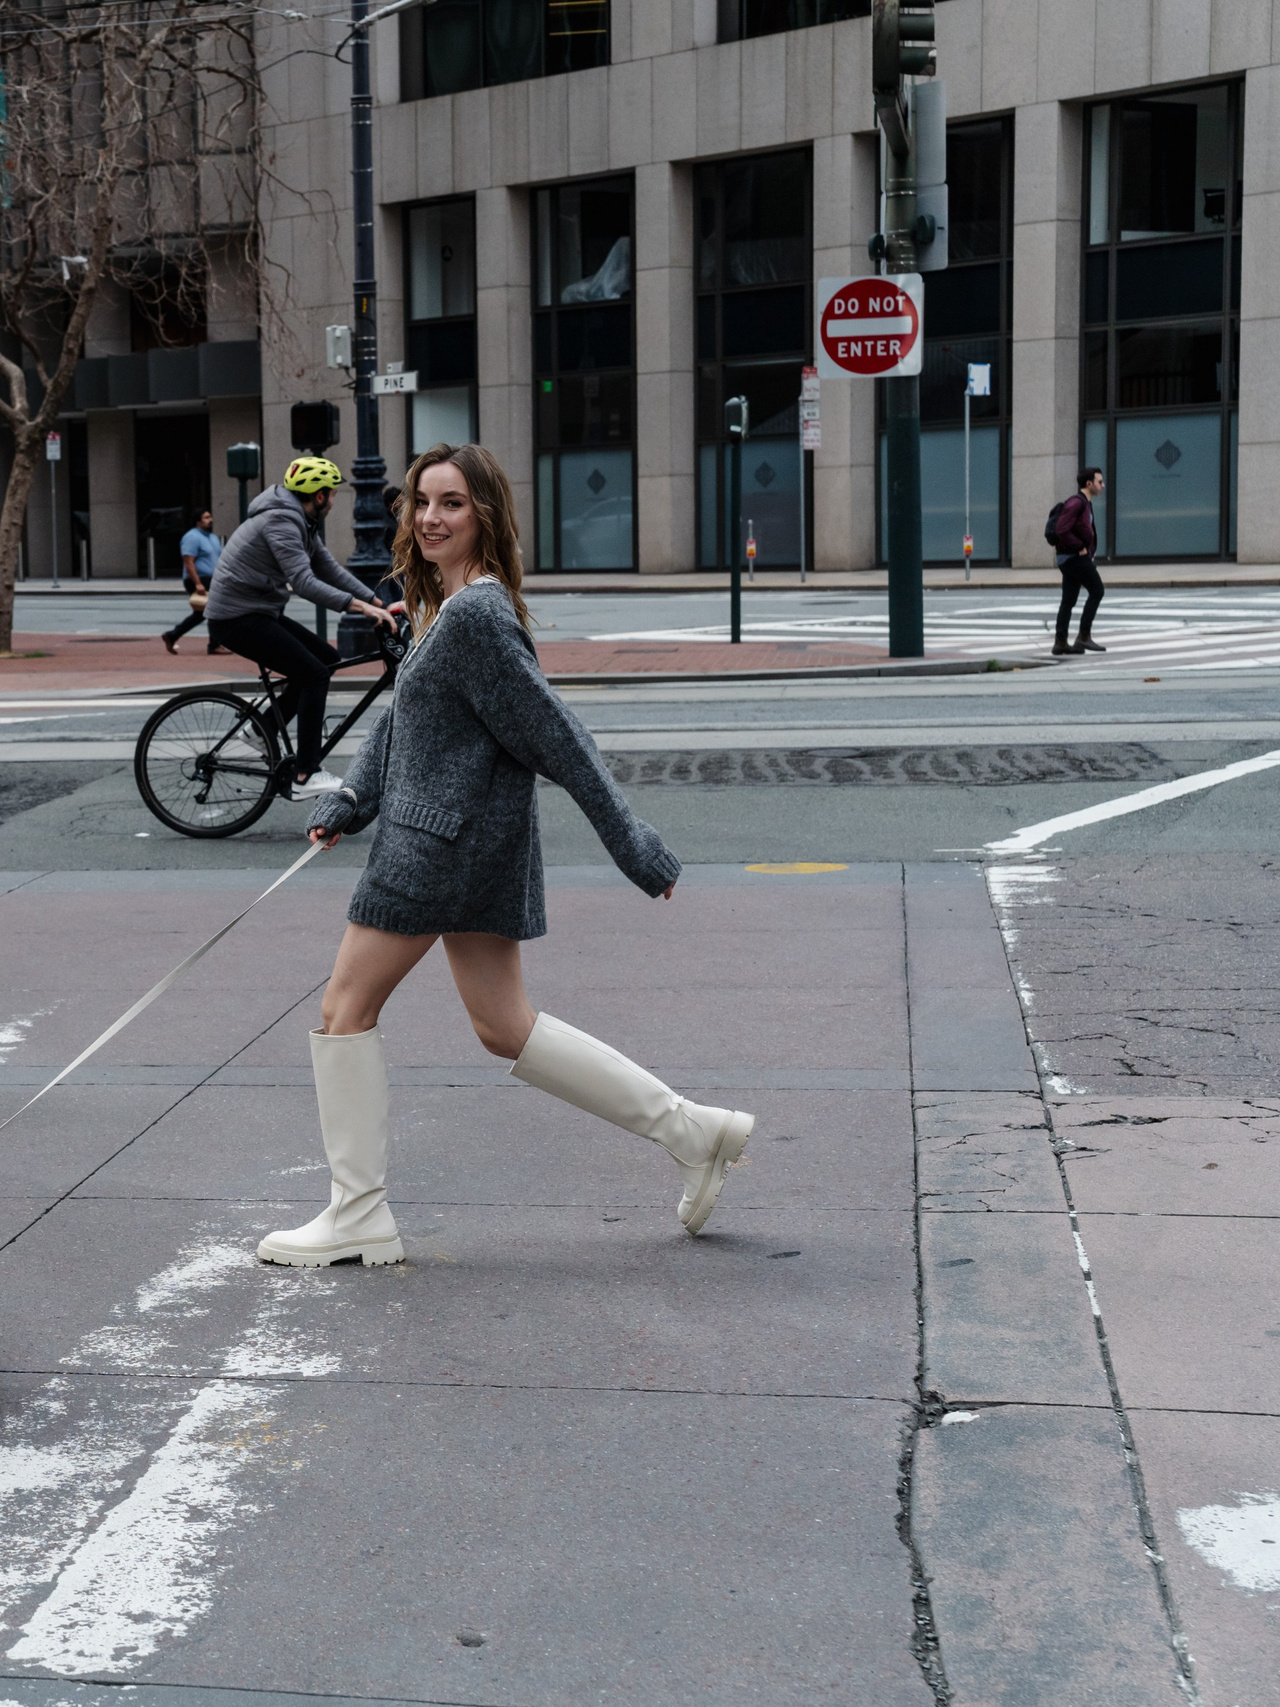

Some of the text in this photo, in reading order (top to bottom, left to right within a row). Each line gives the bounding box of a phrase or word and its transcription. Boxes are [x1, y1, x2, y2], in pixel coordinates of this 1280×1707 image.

[834, 295, 906, 315] DO NOT
[837, 340, 901, 358] ENTER
[383, 376, 405, 390] PINE
